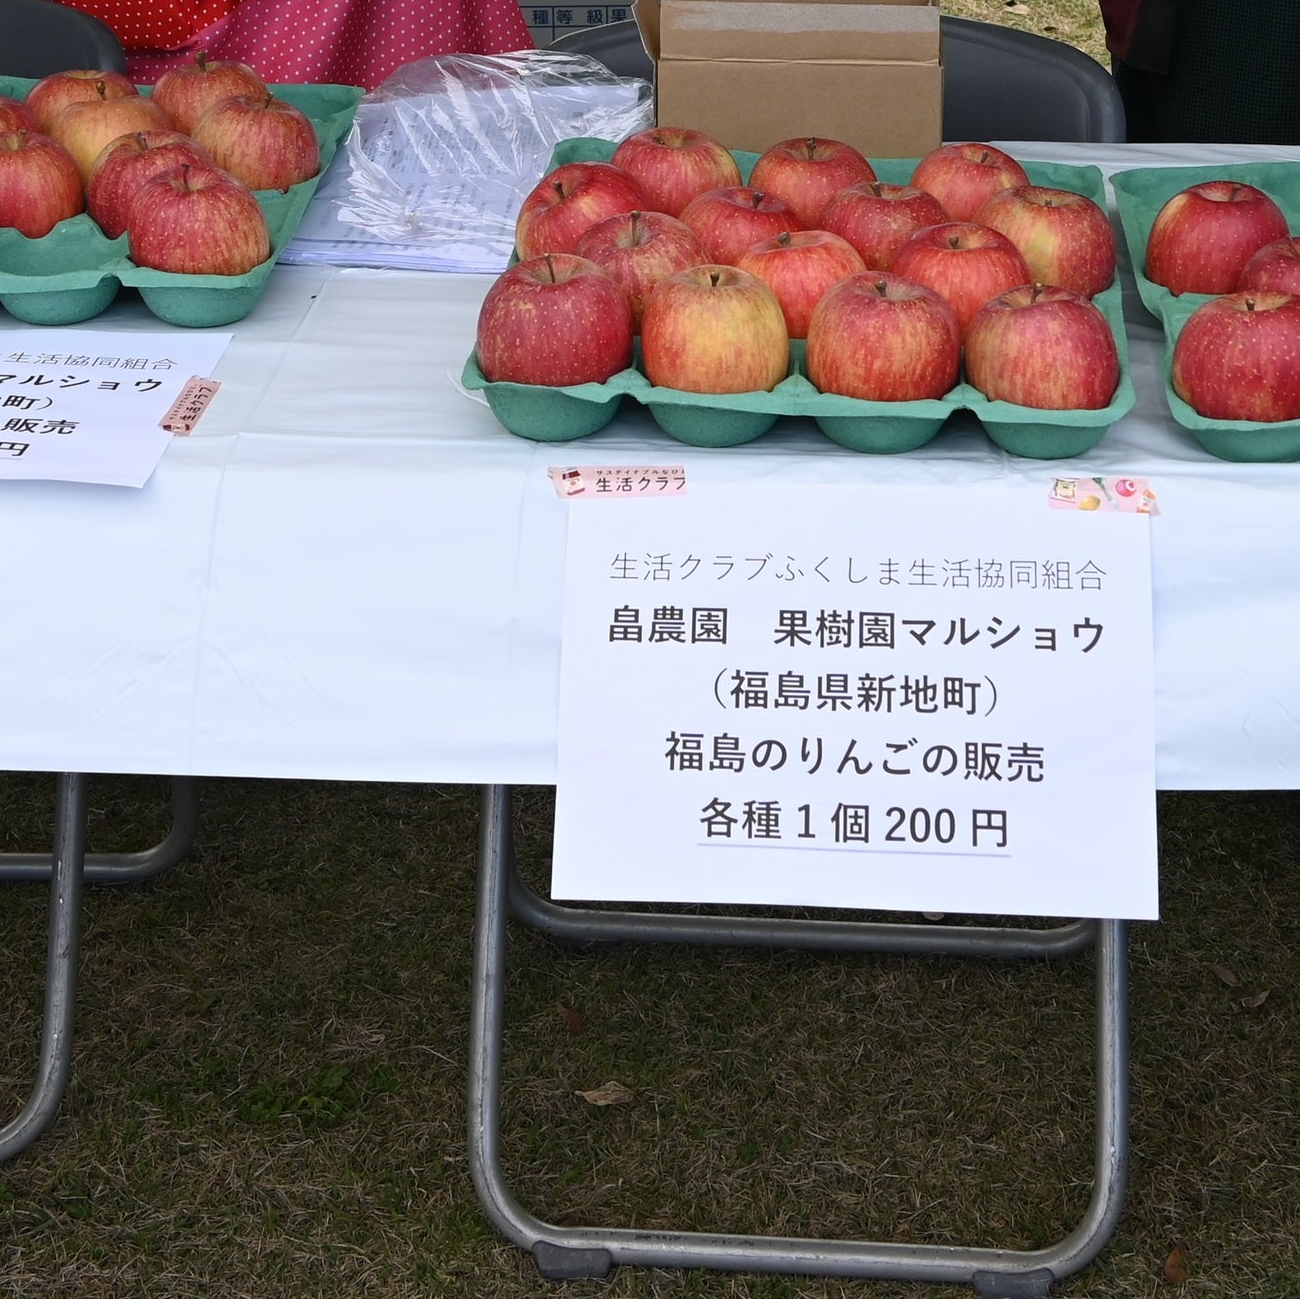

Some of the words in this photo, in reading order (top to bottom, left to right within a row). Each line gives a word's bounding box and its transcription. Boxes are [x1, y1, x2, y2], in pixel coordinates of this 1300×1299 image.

[609, 551, 1108, 592] 生活クラブふくしま生活協同組合
[607, 605, 729, 647] 畠農園
[773, 609, 1106, 654] 果樹園マルショウ
[712, 668, 1000, 718] （福島県新地町）
[664, 731, 1047, 783] 福島のりんごの販売
